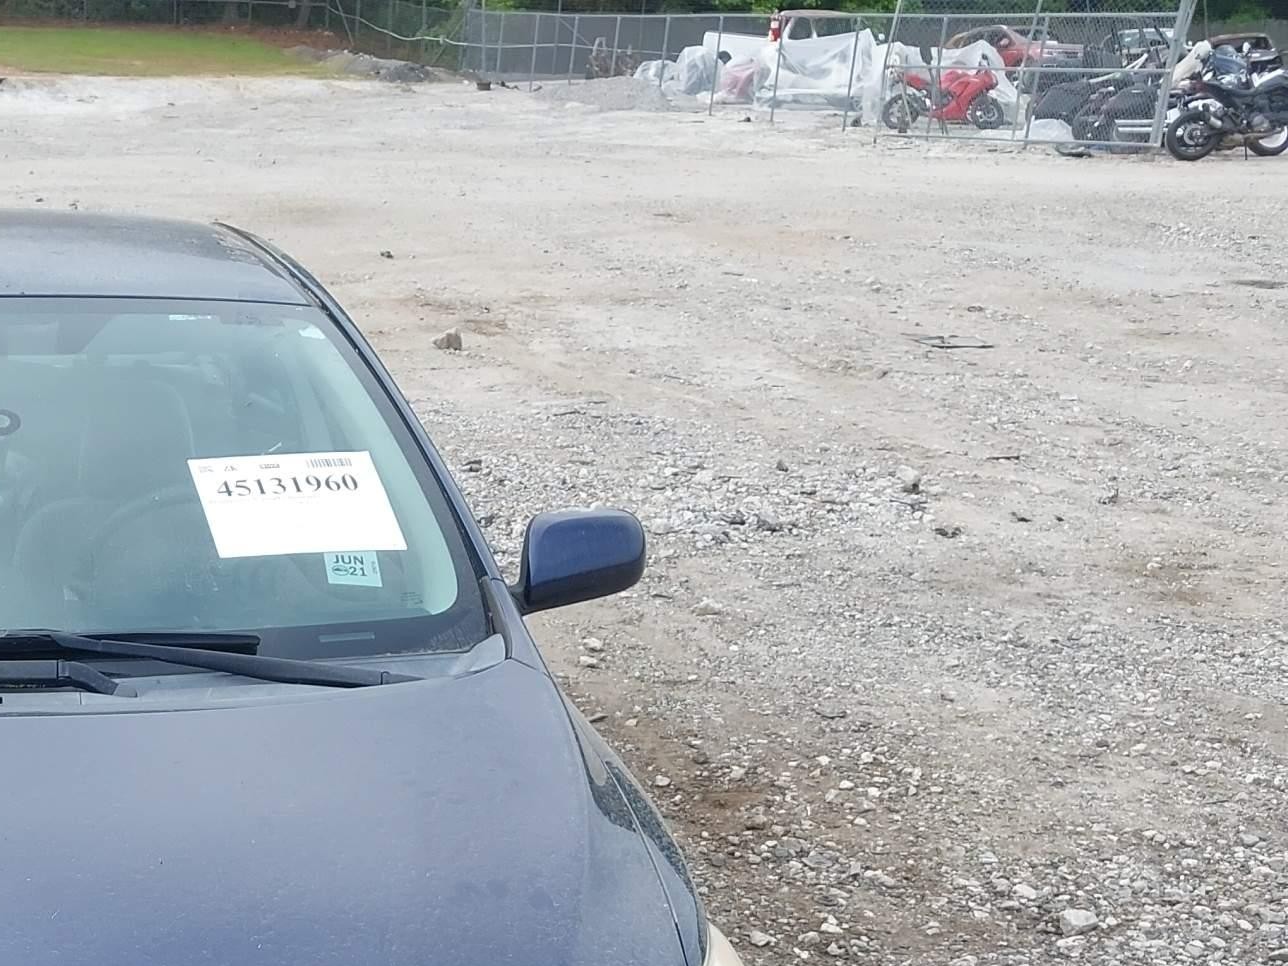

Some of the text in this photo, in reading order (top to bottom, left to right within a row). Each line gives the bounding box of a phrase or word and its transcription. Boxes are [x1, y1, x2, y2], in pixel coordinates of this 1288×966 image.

[217, 473, 358, 497] 45131960
[333, 554, 364, 565] JUN
[348, 566, 367, 577] 21
